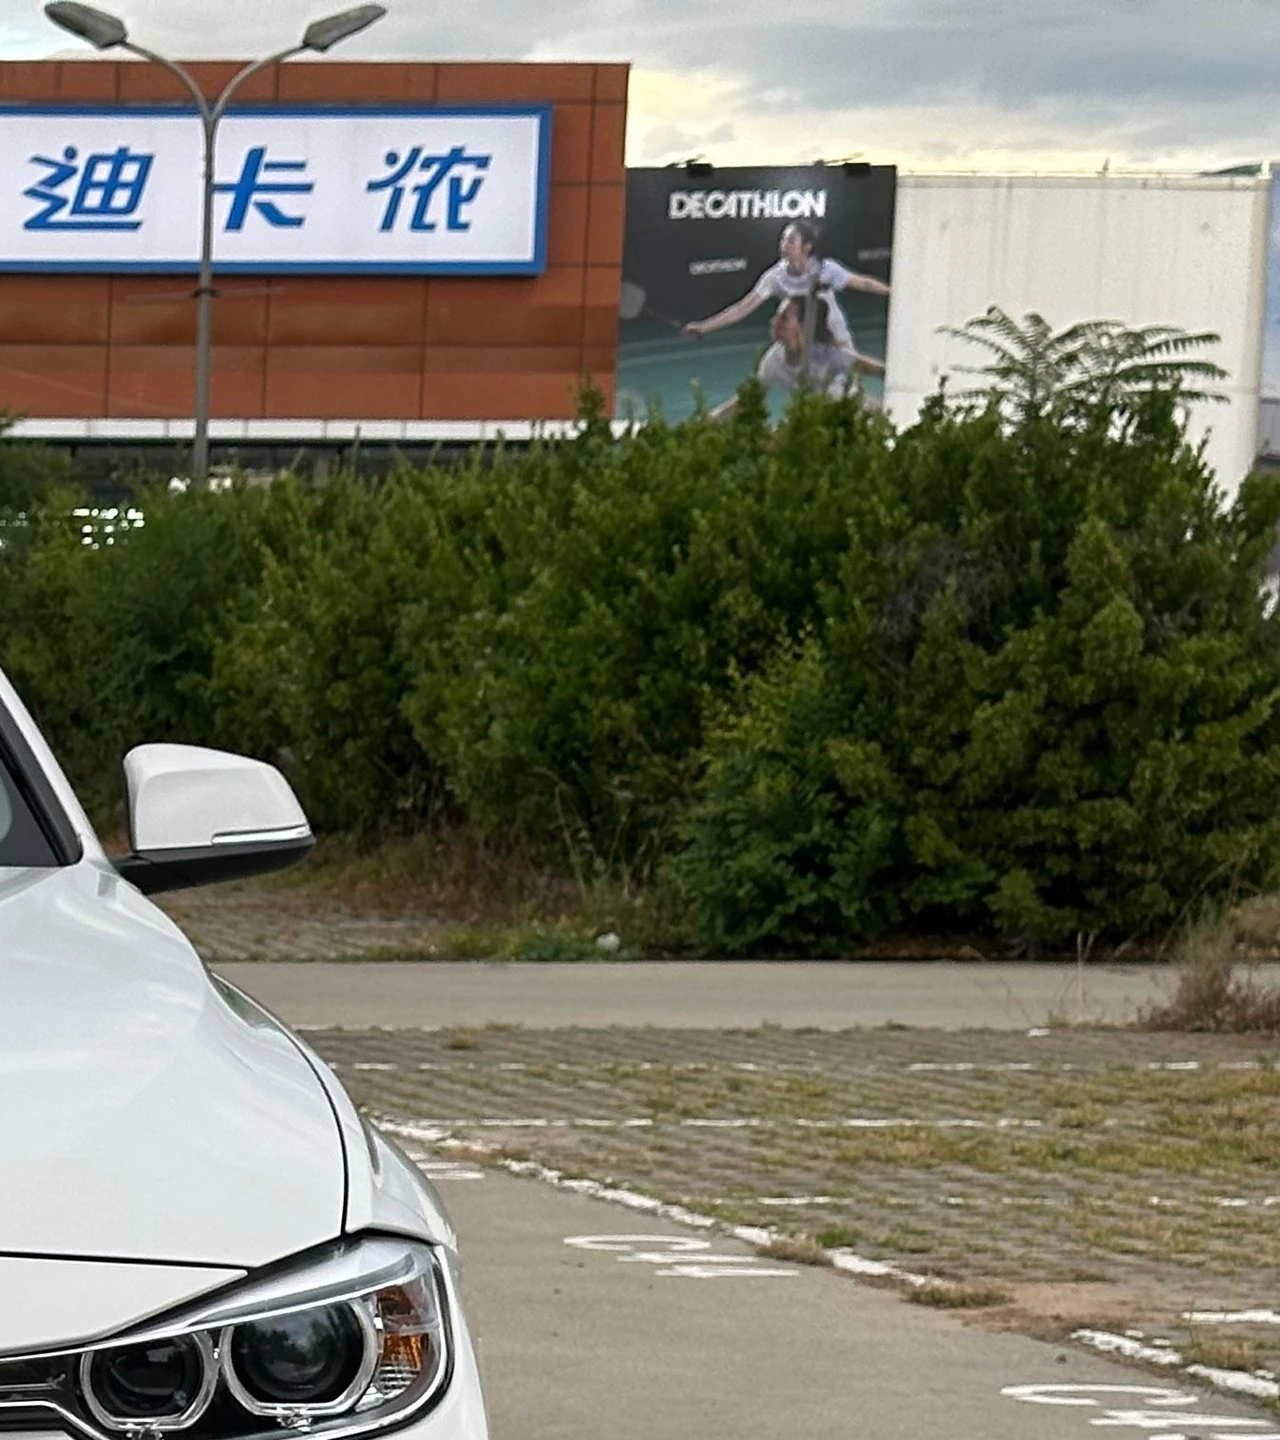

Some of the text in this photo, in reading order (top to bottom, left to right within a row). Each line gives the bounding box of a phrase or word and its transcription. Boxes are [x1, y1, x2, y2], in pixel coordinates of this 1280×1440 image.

[23, 146, 490, 232] 迪卡侬
[669, 189, 827, 219] DECATHLON
